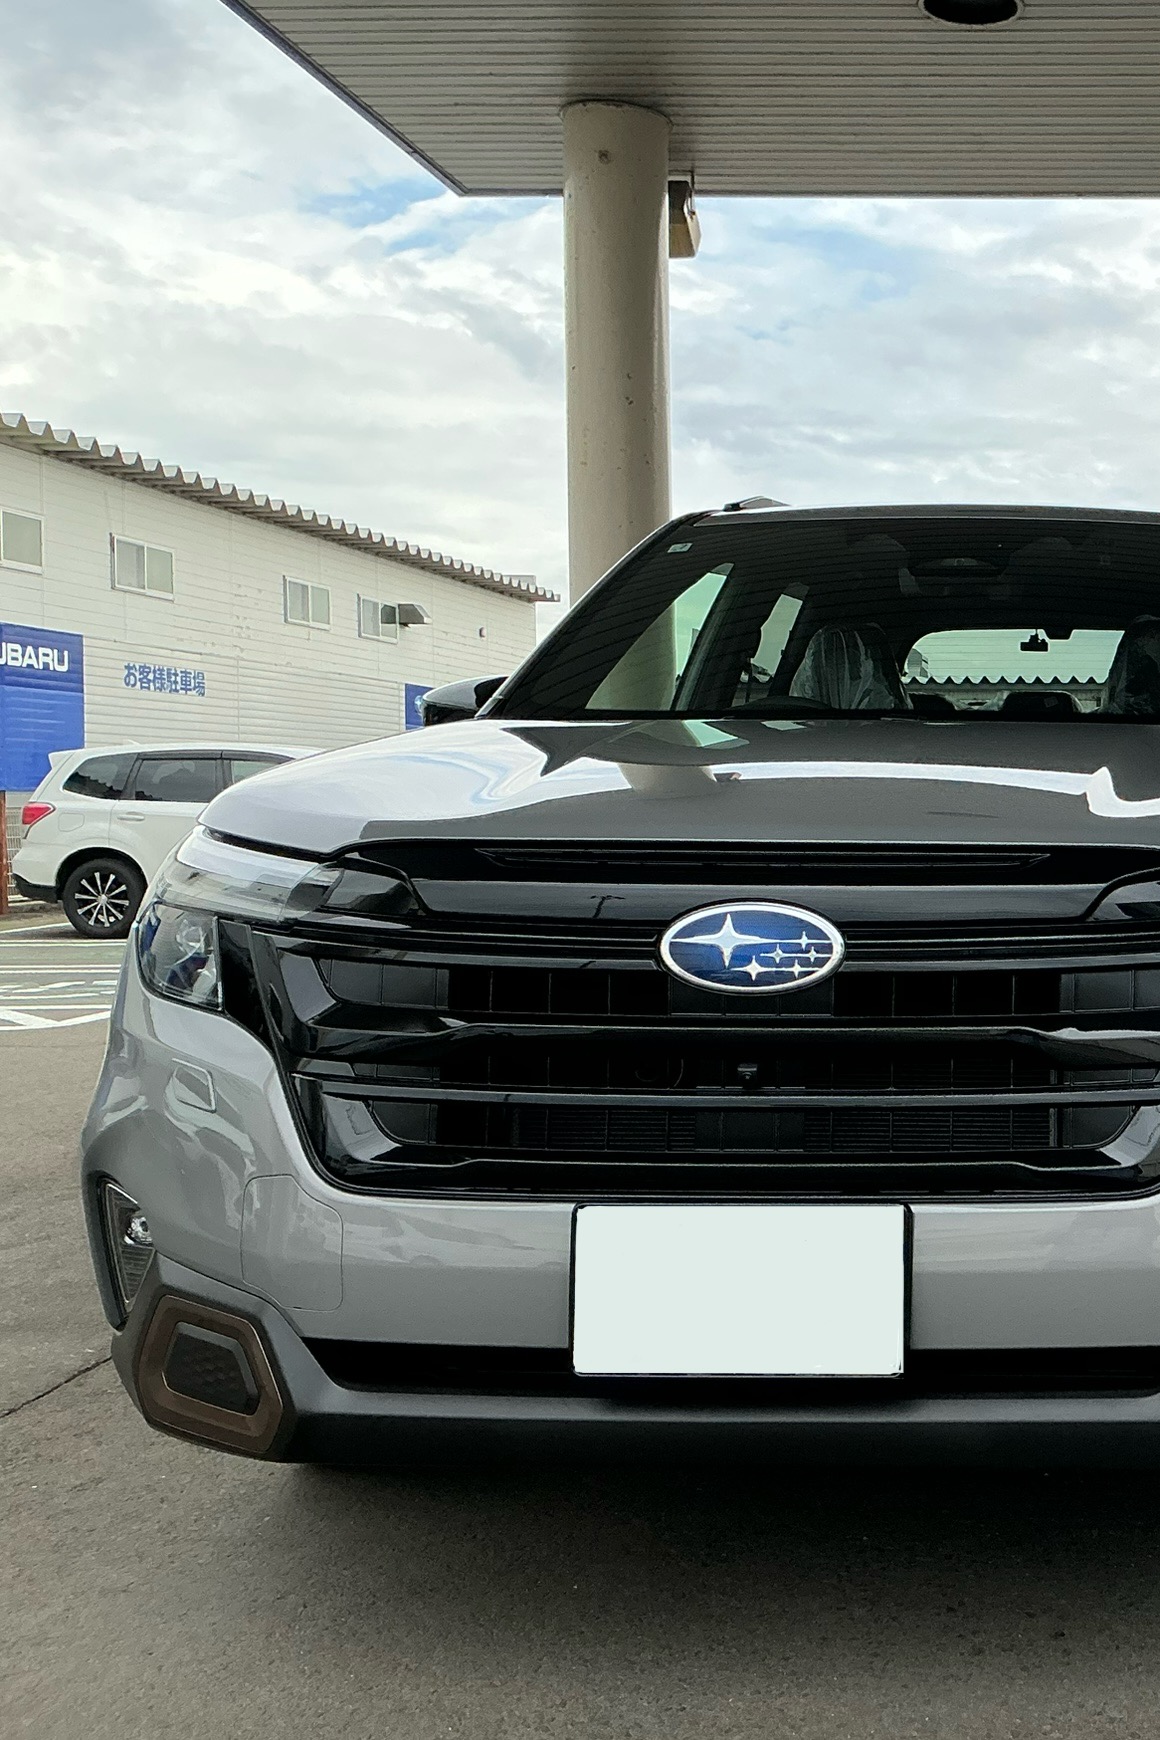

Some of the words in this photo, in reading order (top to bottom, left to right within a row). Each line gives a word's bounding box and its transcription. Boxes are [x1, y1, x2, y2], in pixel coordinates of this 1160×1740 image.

[124, 663, 205, 696] お客様駐車場
